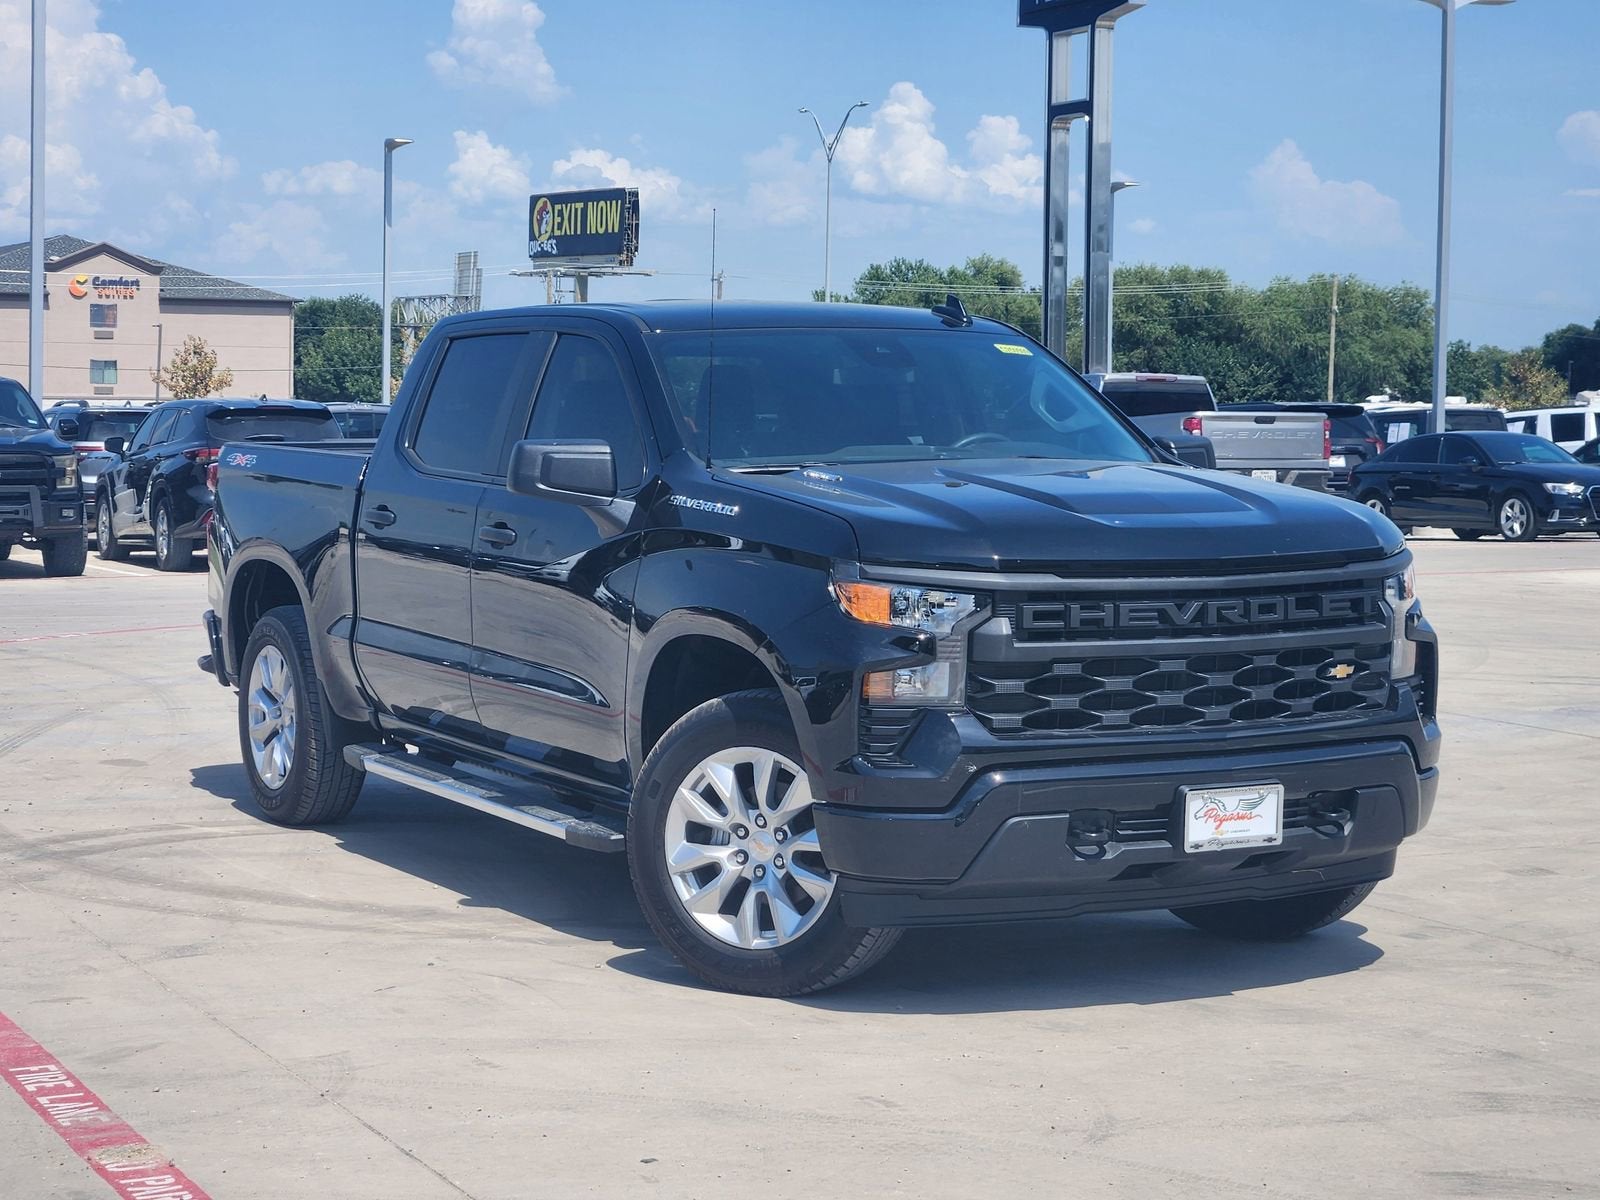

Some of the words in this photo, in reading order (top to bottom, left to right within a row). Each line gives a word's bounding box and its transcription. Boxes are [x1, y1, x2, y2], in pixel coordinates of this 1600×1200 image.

[554, 202, 583, 235] EXIT
[587, 200, 621, 234] NOW
[92, 276, 140, 290] Comfort
[1211, 430, 1318, 439] CHEVROLET
[670, 494, 739, 516] SILVERADO
[1022, 594, 1378, 628] CHEVROLET
[1204, 807, 1257, 830] Pegasus
[9, 1065, 75, 1091] FIRE
[36, 1093, 110, 1125] LANE
